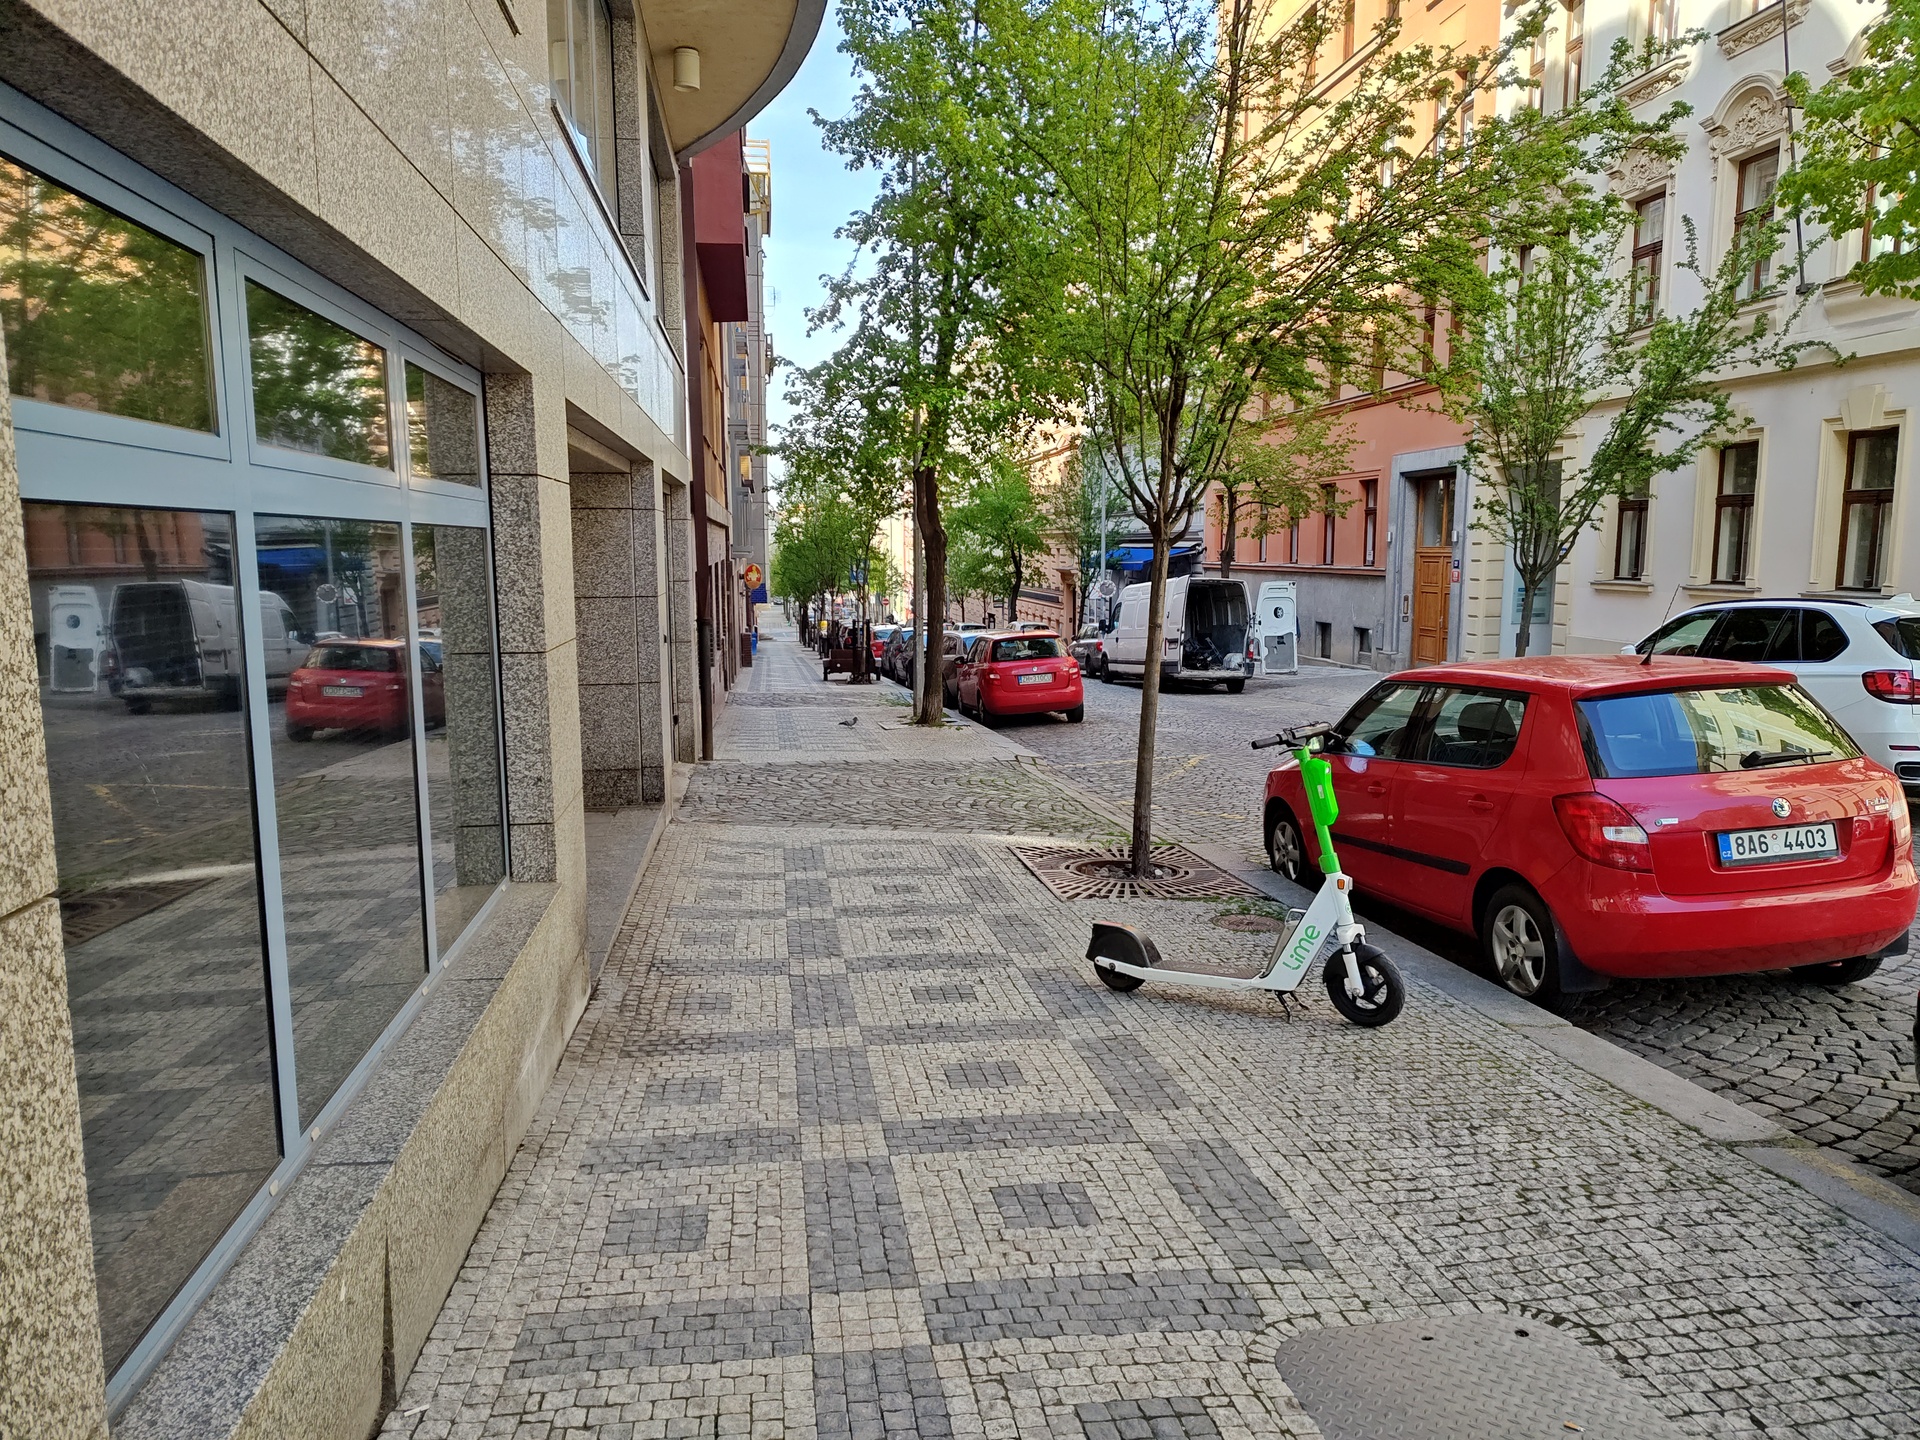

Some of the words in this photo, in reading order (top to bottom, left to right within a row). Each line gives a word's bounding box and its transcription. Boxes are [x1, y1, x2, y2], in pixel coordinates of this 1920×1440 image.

[1735, 834, 1769, 856] 8A6
[1784, 828, 1827, 851] 4403
[1282, 925, 1321, 970] Lime
